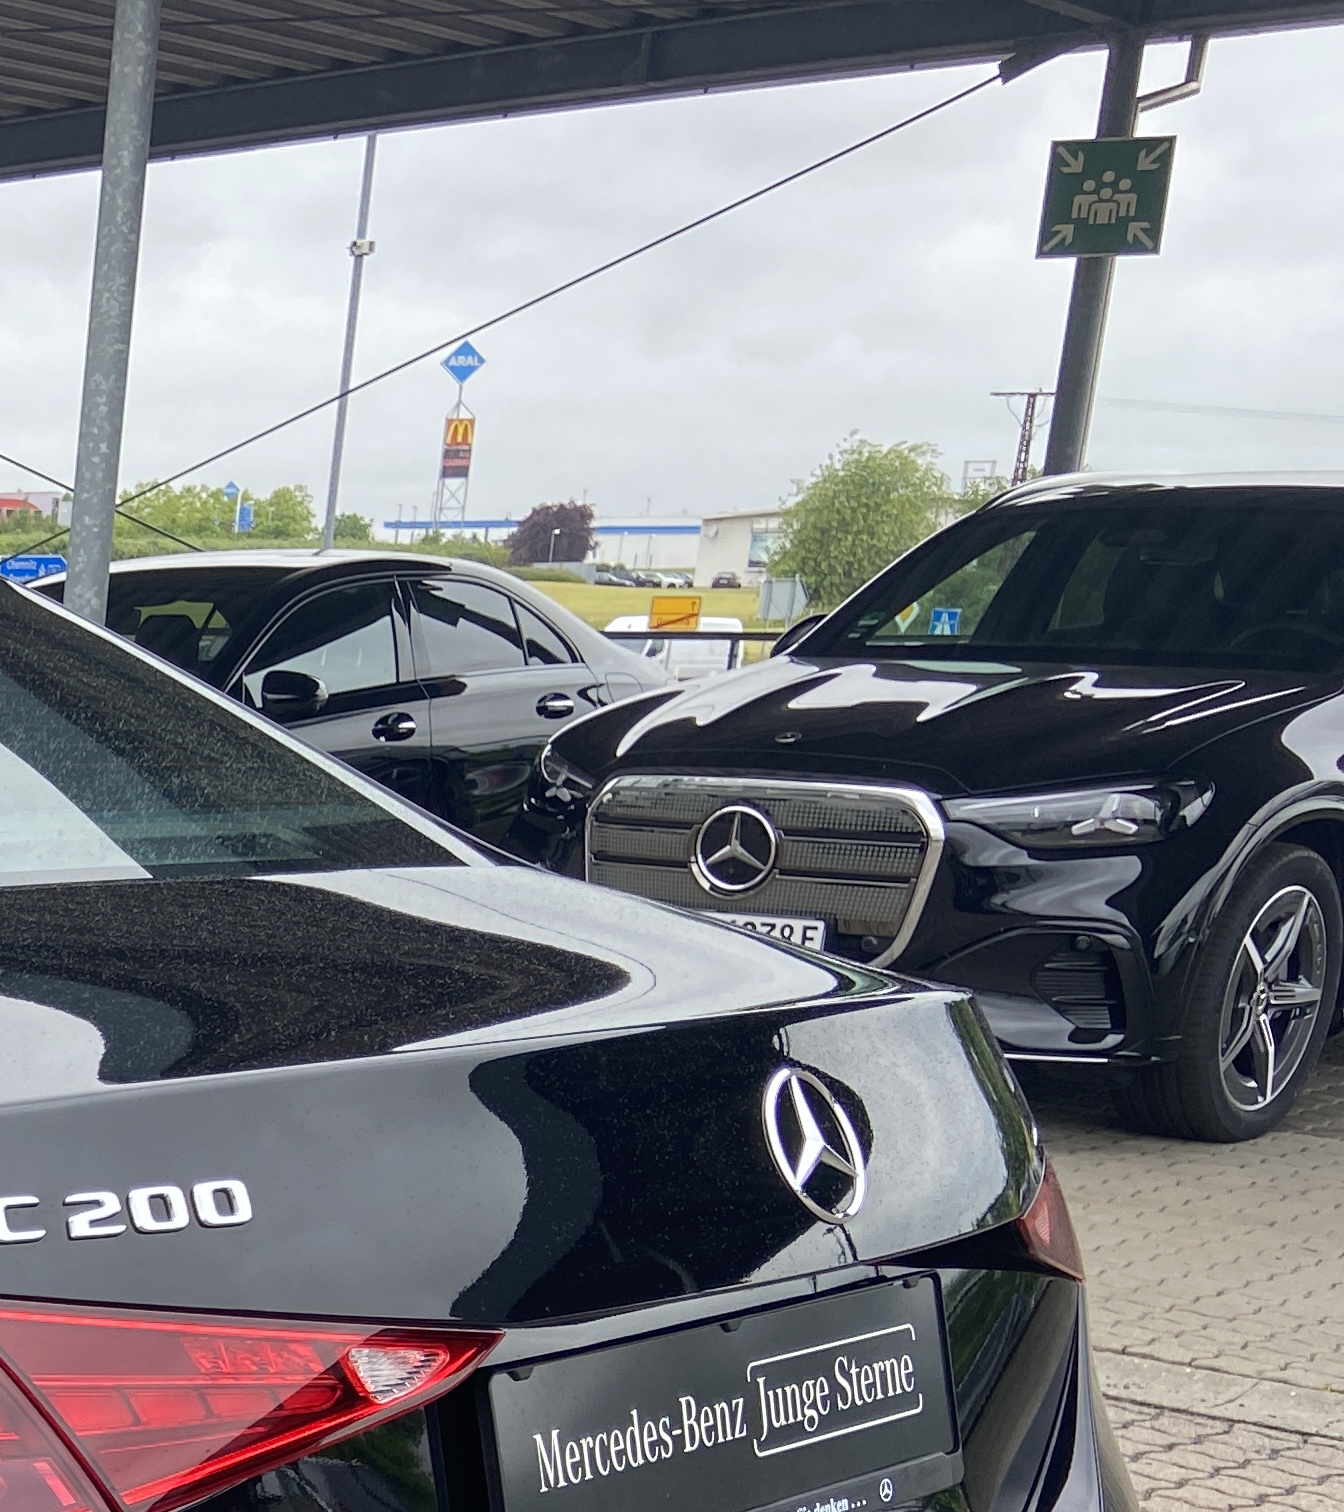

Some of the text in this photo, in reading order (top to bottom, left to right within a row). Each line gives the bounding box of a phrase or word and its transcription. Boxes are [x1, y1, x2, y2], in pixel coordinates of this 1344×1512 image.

[448, 355, 481, 367] ARAL
[63, 1180, 253, 1241] 200
[532, 1354, 915, 1493] Mercedes-Benz Junge Sterne
